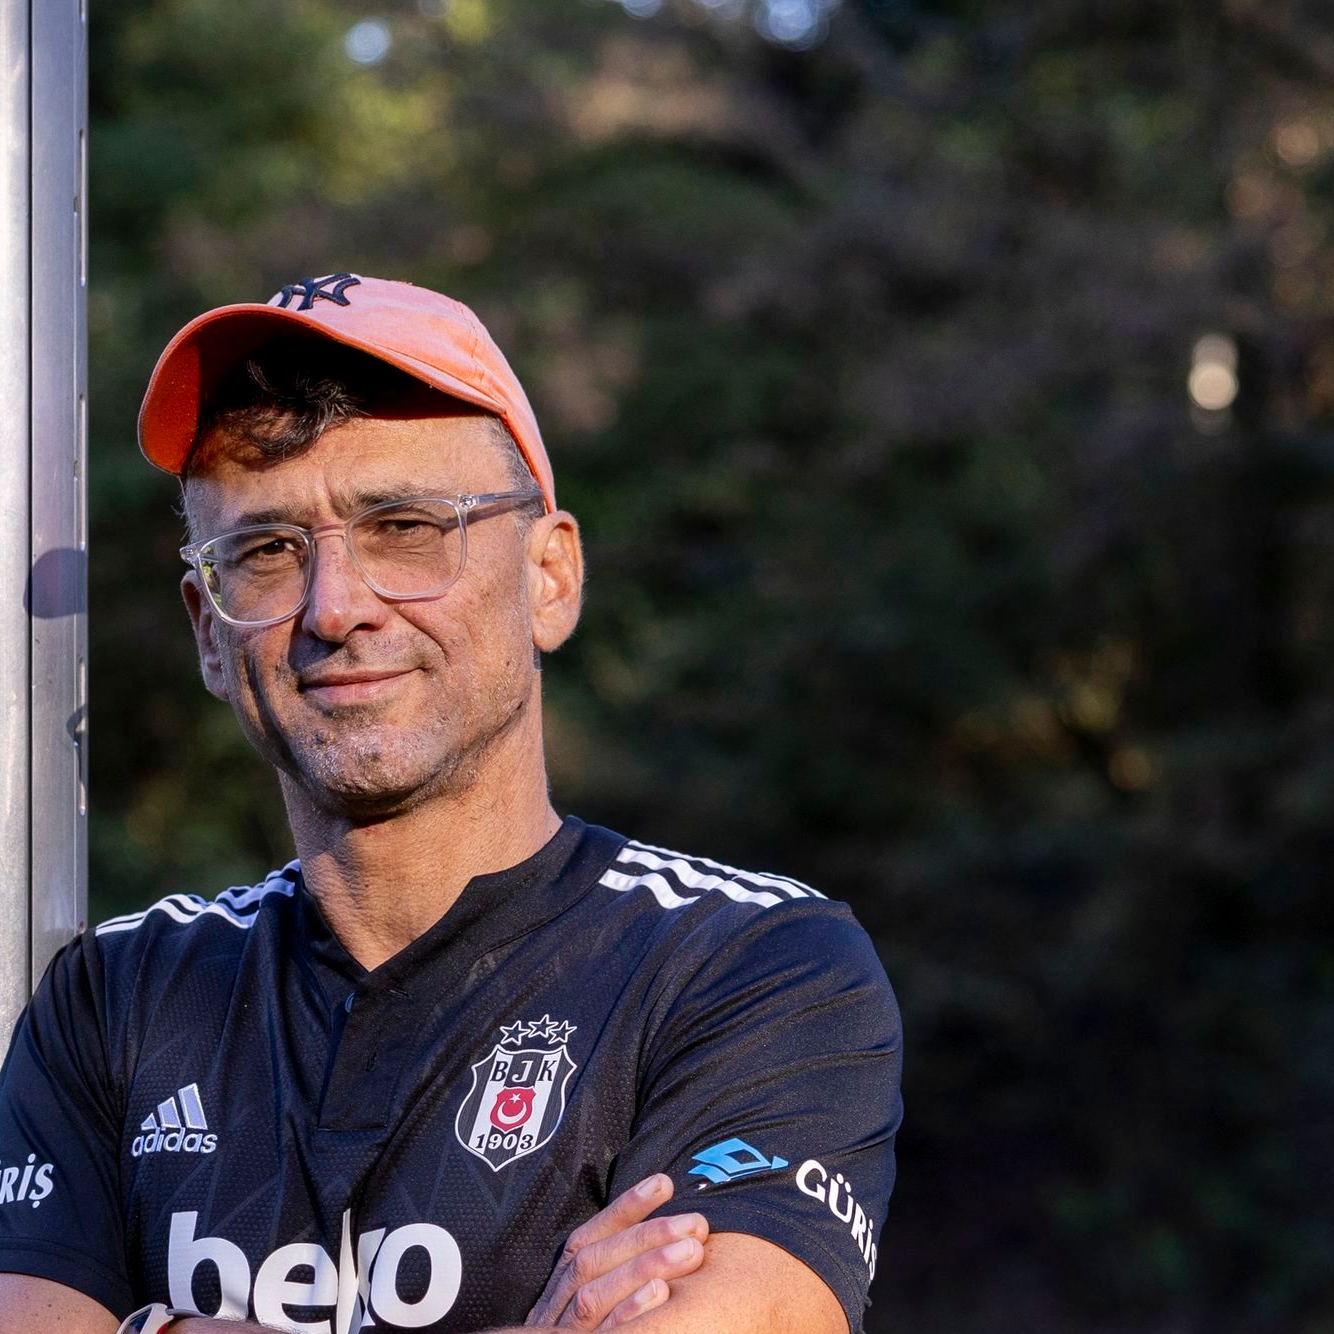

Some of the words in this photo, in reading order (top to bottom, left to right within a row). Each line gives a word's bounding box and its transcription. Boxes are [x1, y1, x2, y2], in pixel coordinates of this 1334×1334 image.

[489, 1059, 557, 1082] BJK
[131, 1127, 218, 1157] adidas
[474, 1133, 534, 1150] 1903
